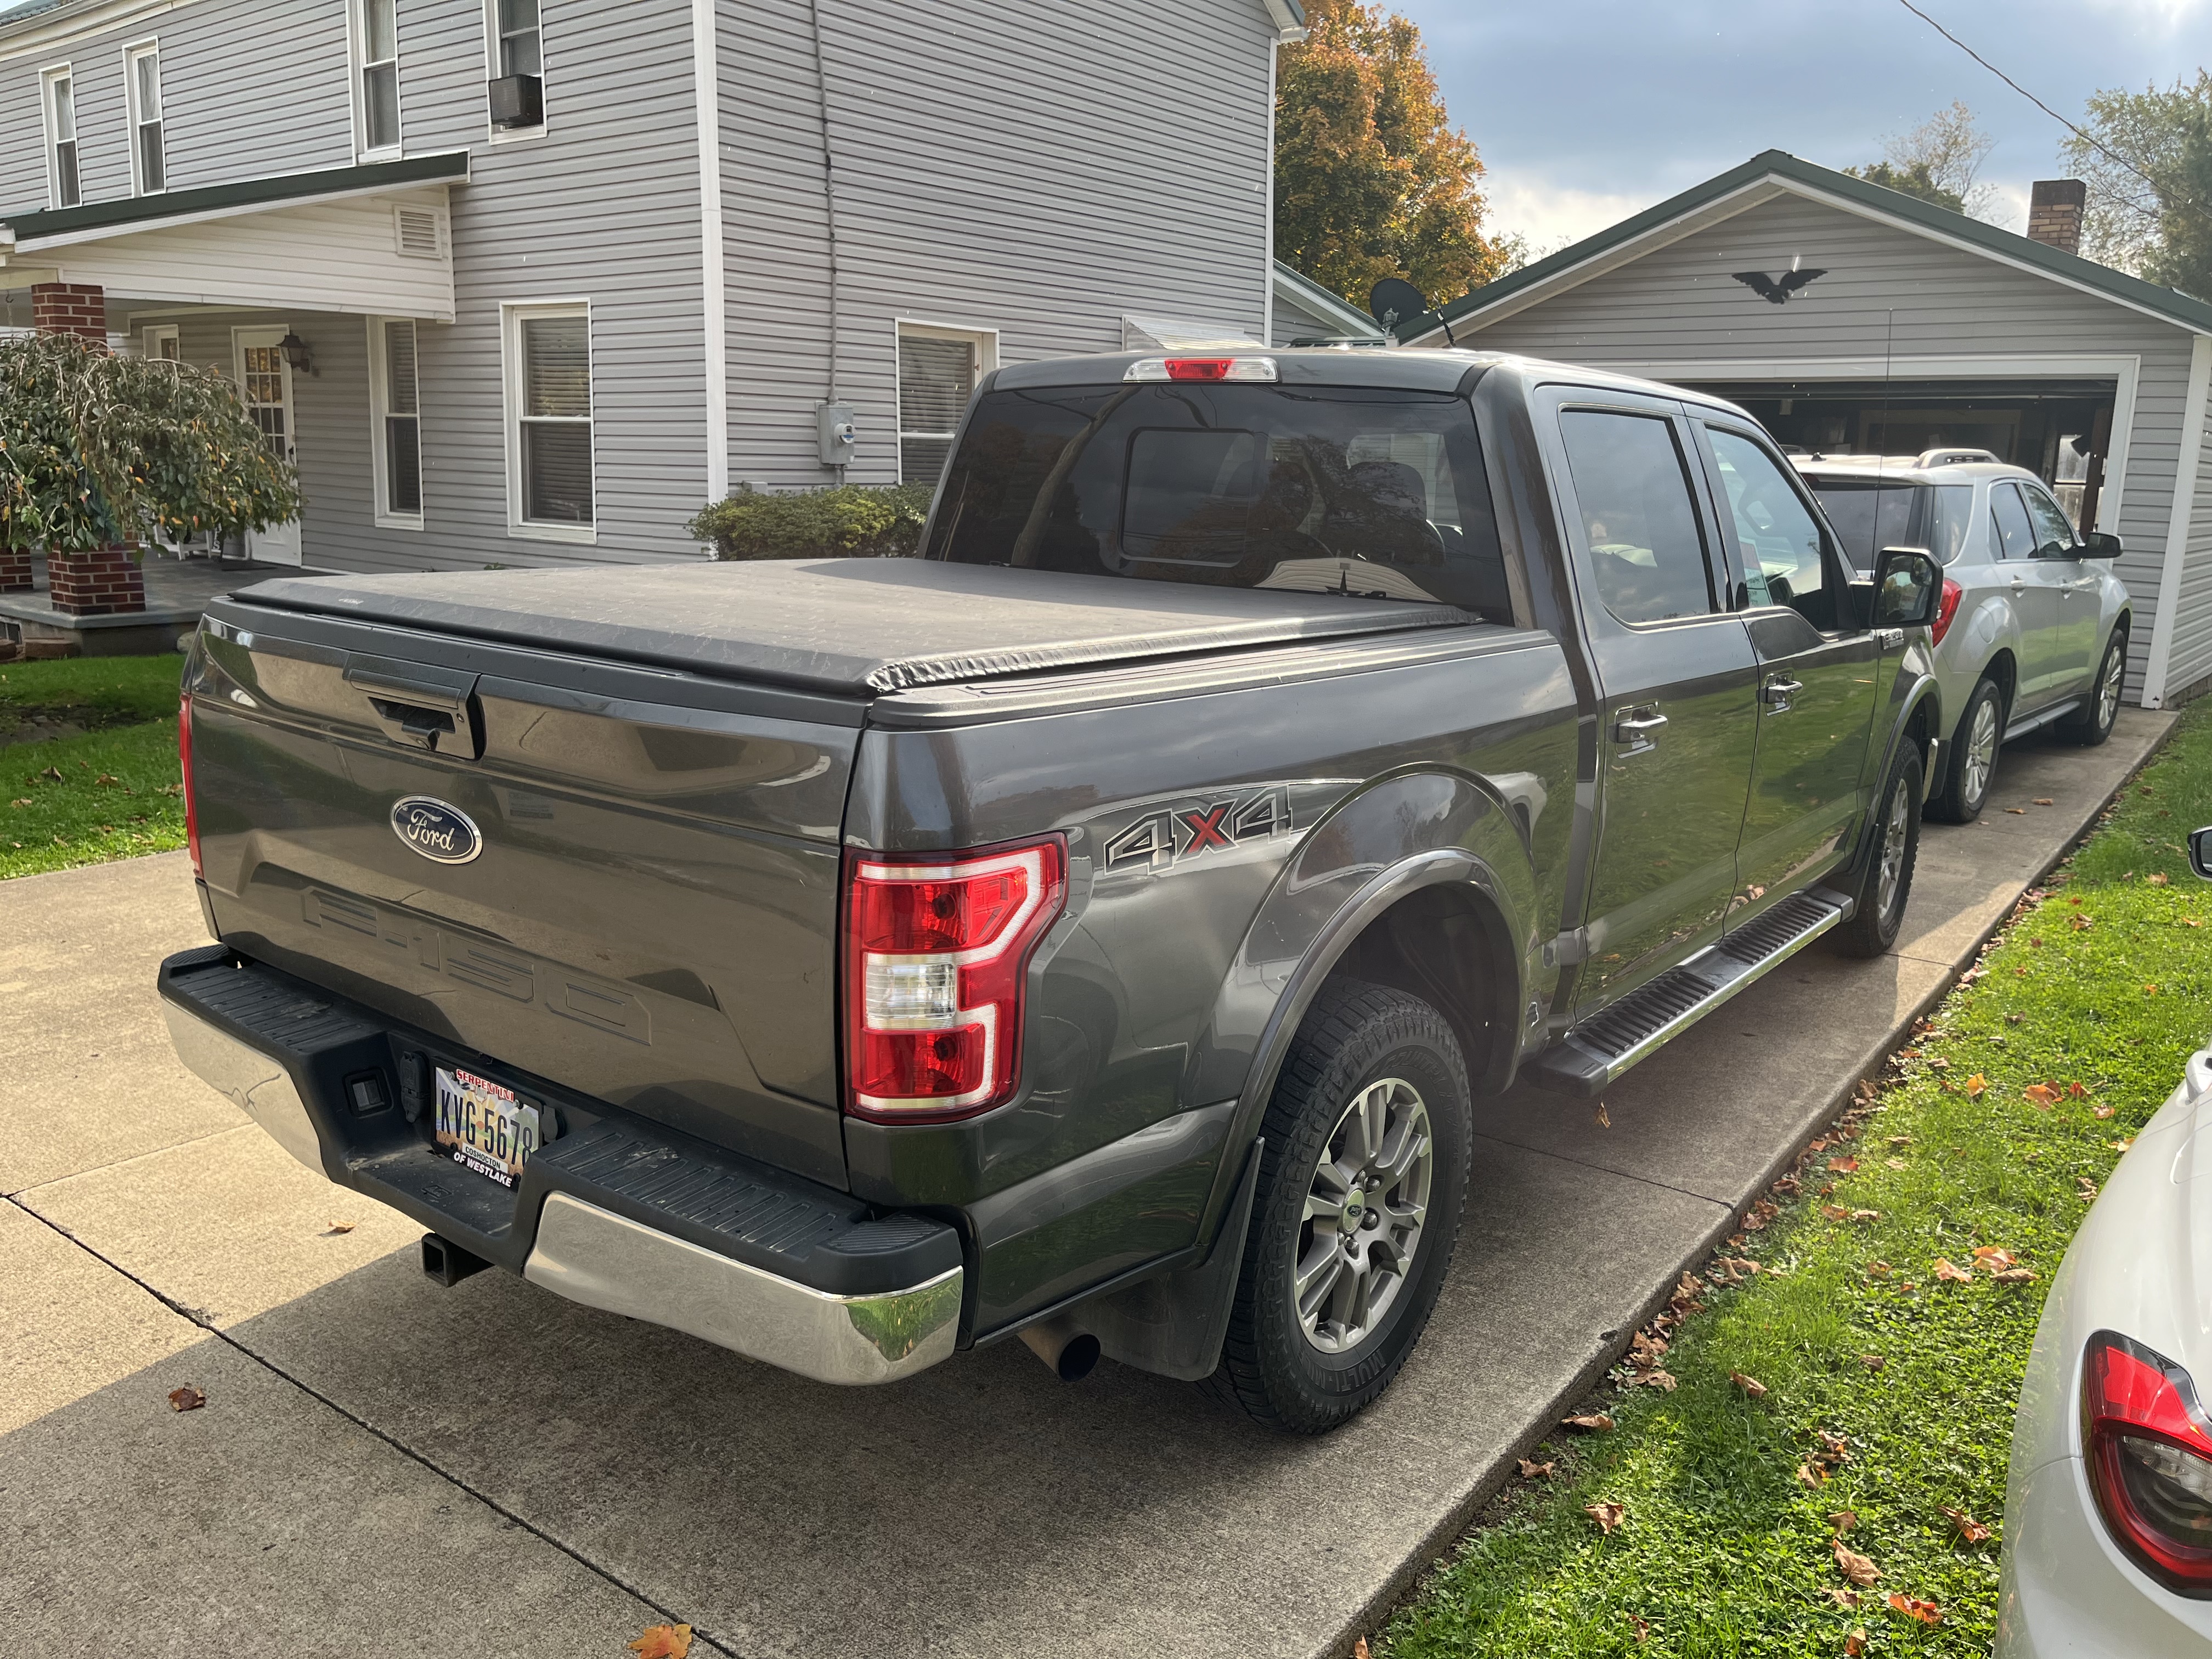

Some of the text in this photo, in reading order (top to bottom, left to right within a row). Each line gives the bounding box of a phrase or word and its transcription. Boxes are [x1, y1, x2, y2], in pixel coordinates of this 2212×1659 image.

[408, 809, 455, 851] Ford
[1103, 784, 1293, 876] 4X4
[456, 1068, 515, 1103] SERPENTINI
[441, 1088, 533, 1168] KVG 5678
[453, 1152, 512, 1188] OF WESTLAKE
[465, 1146, 501, 1170] COSHOCTON
